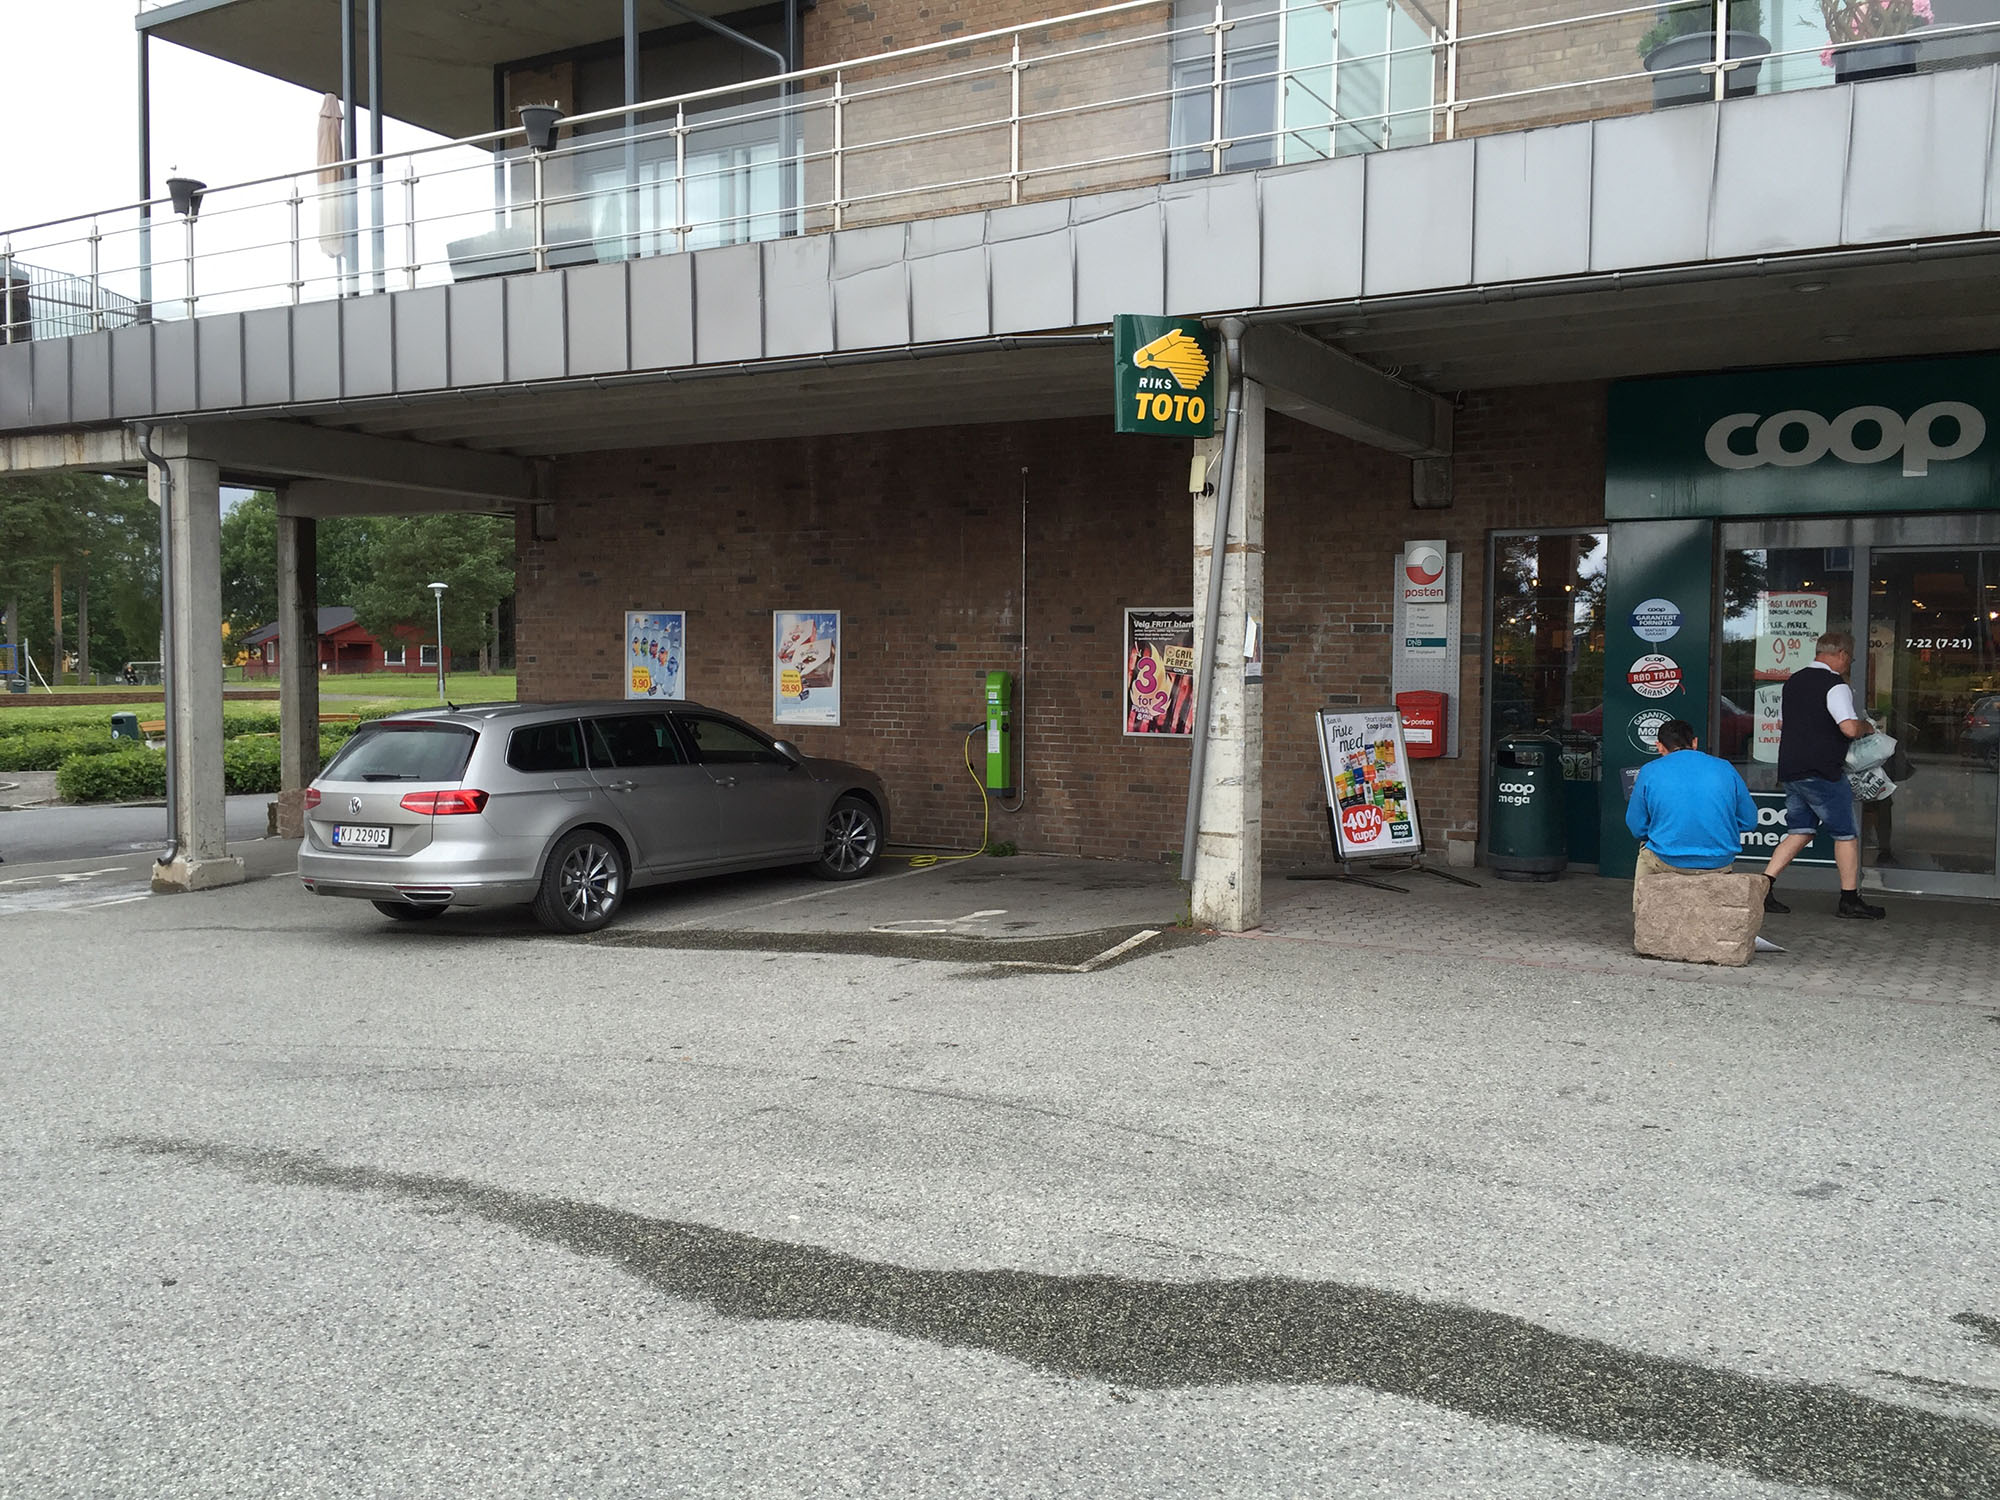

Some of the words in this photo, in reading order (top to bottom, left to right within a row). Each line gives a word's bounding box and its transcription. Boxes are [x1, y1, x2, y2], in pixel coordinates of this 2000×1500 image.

[1139, 377, 1172, 390] RIKS
[1135, 392, 1206, 424] TOTO
[1704, 401, 1987, 477] coop
[1405, 588, 1443, 598] posten
[1785, 599, 1817, 608] LAVPRIS
[1133, 620, 1150, 629] Velg
[1151, 620, 1172, 628] FRITT
[1905, 638, 1932, 648] 7-22
[1936, 638, 1973, 649] (7-21)
[1772, 637, 1786, 664] 9
[1787, 637, 1801, 649] 90
[1166, 657, 1193, 668] PERFEK
[1135, 657, 1157, 695] 3
[1633, 673, 1651, 682] RØD
[1653, 669, 1677, 680] TRÅD
[632, 678, 648, 688] 9,90
[781, 683, 800, 692] 28,90
[1138, 695, 1152, 705] for
[1152, 691, 1168, 713] 2
[1633, 712, 1671, 726] GARANTER
[1331, 724, 1353, 743] friste
[1339, 732, 1364, 753] med
[1499, 783, 1535, 796] coop
[1499, 795, 1530, 806] mega
[1343, 808, 1381, 831] -40%
[340, 828, 353, 841] KJ
[355, 828, 386, 843] 22905
[1351, 827, 1377, 842] kupp!
